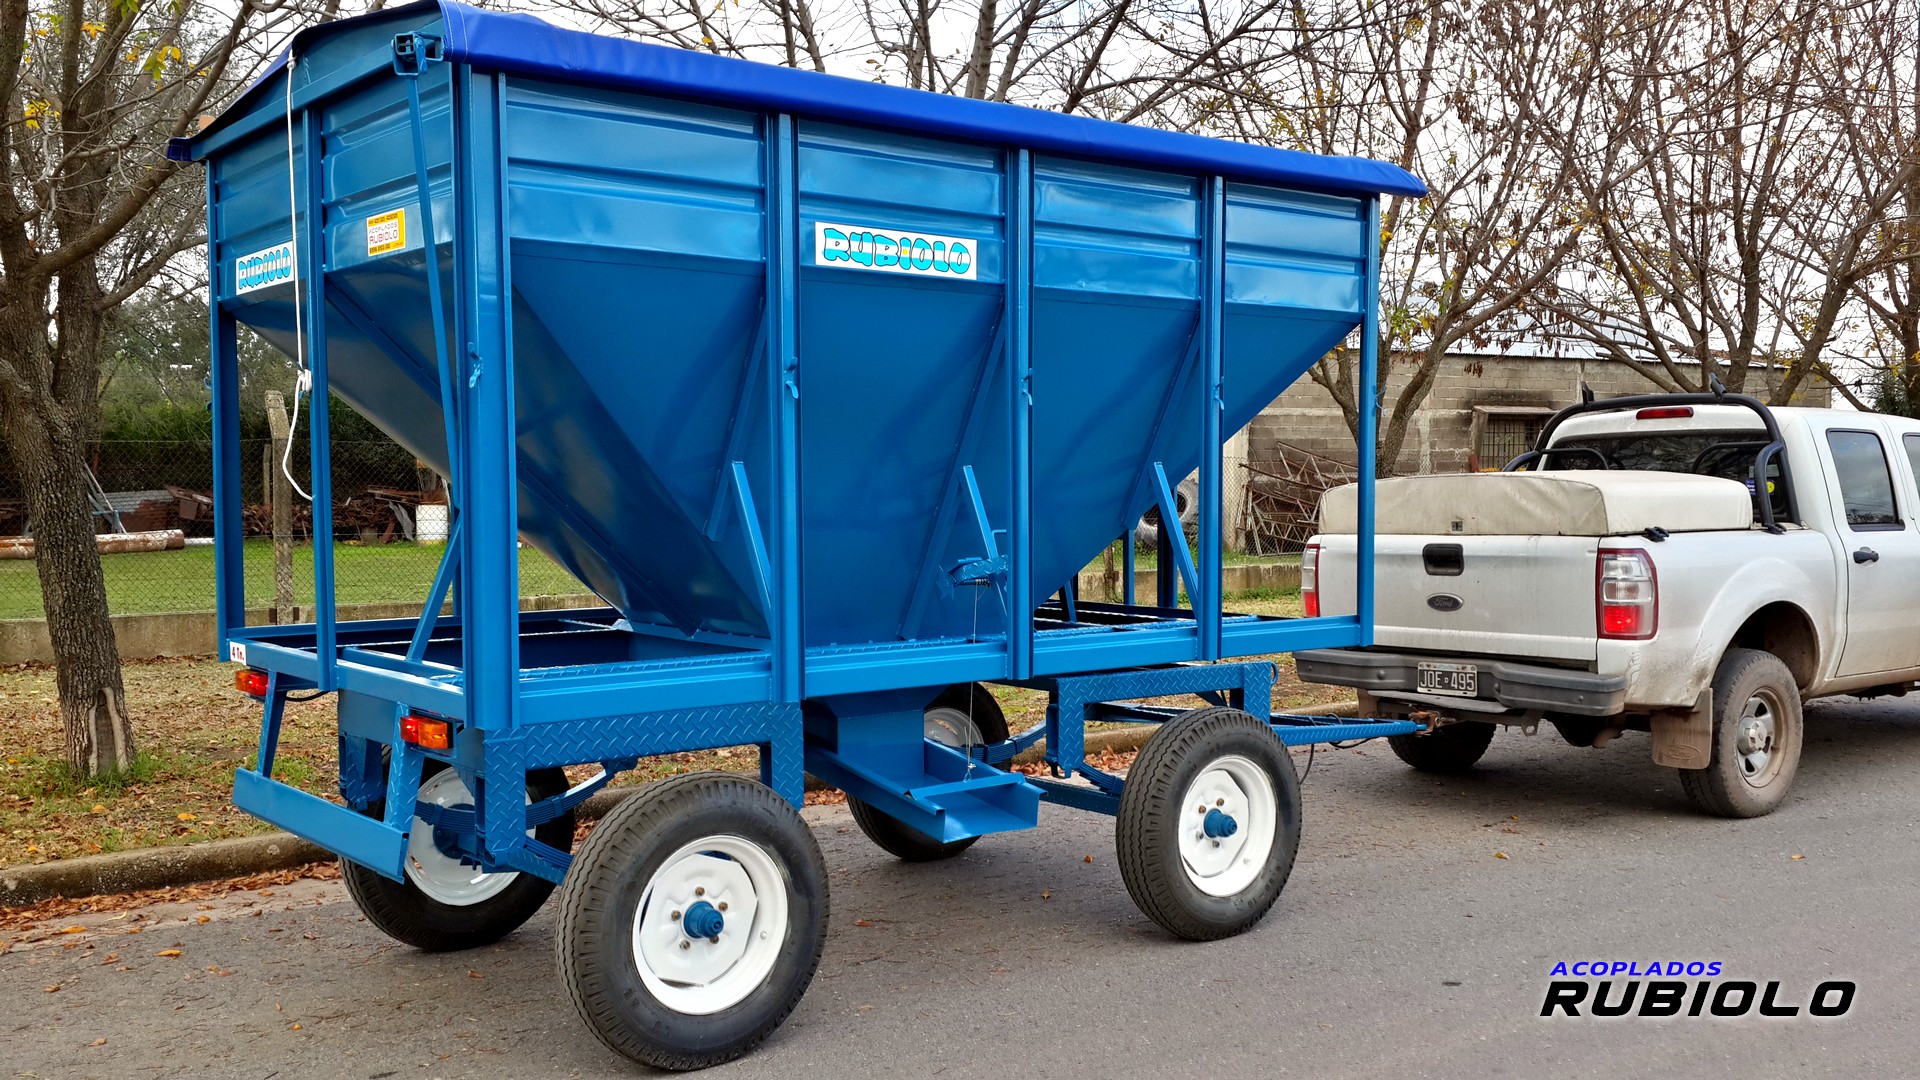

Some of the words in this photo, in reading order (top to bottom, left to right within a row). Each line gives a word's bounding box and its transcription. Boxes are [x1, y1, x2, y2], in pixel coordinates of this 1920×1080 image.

[369, 230, 398, 245] RUBIOLO
[823, 228, 971, 274] RUBIOLO
[238, 246, 291, 289] RUBIOLO
[1434, 597, 1454, 608] Ford
[1420, 671, 1443, 688] JOE
[1450, 672, 1475, 691] 495
